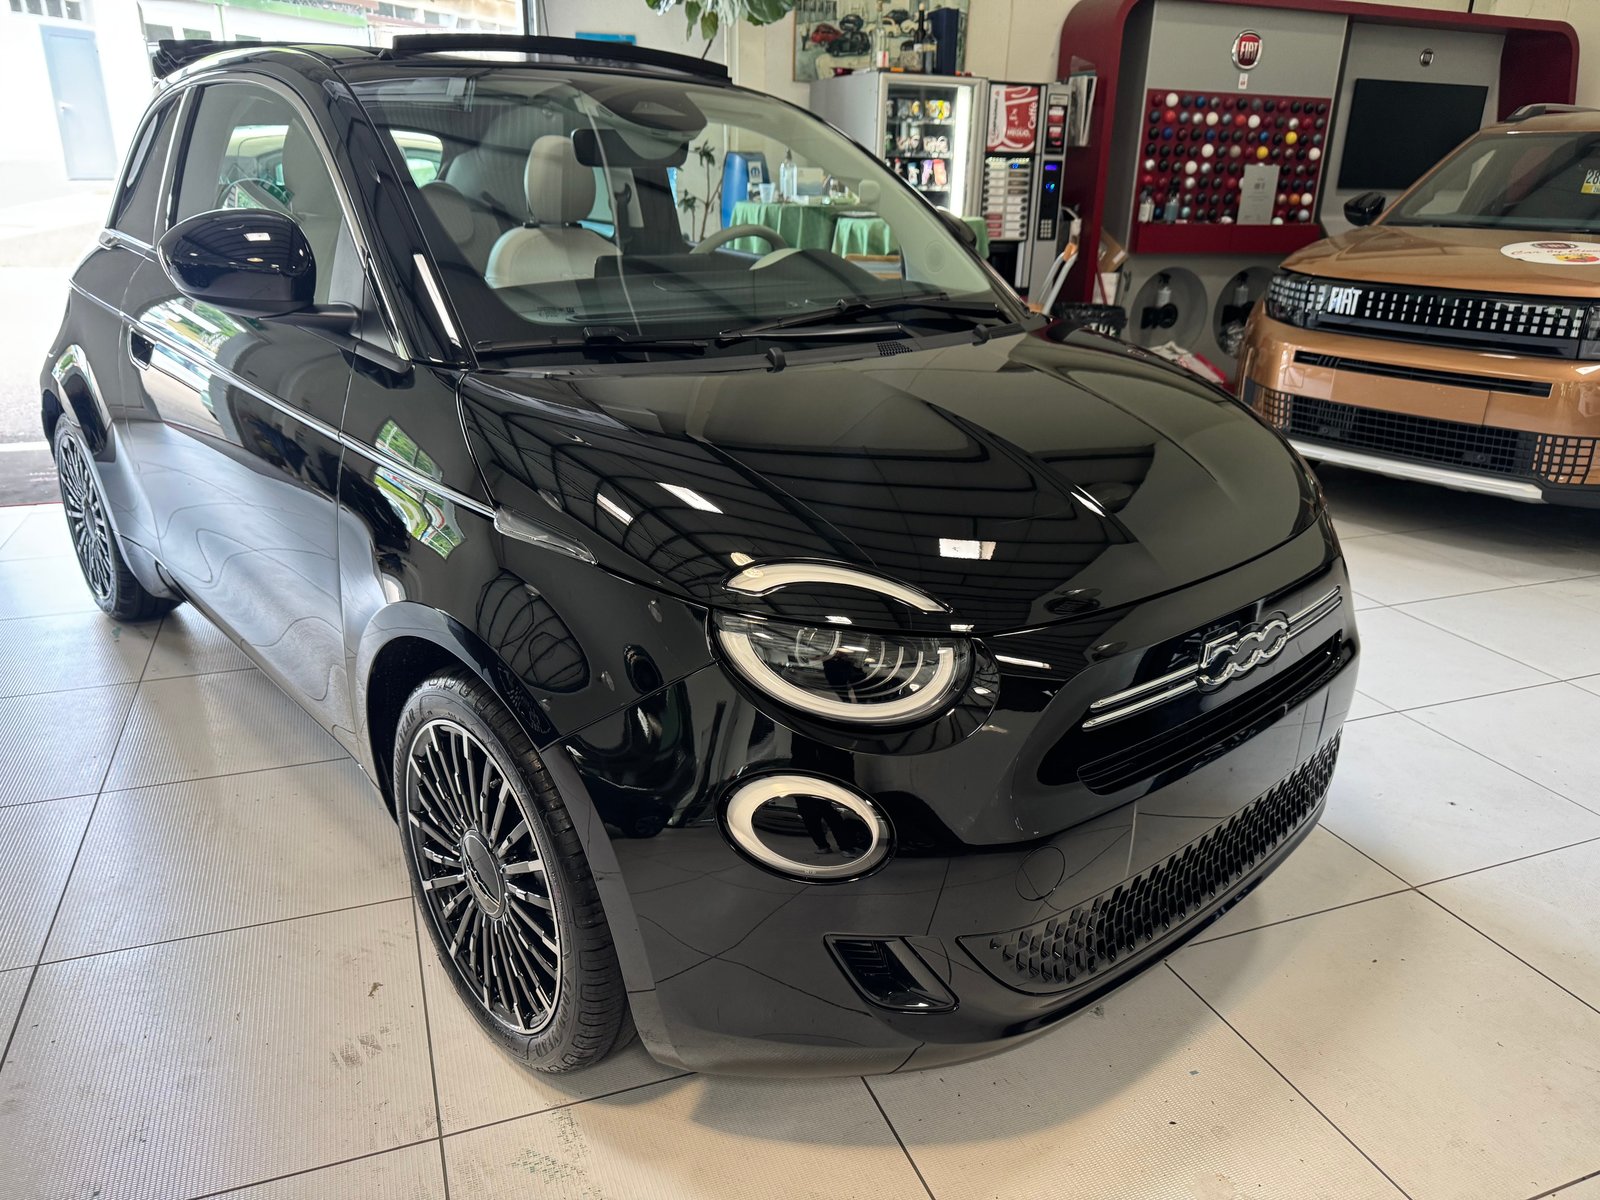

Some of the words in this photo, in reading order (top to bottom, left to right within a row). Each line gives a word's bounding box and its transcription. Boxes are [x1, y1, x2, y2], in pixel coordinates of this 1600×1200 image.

[1240, 41, 1259, 60] FIAT
[1327, 286, 1363, 316] FIAT
[1199, 619, 1289, 686] 500
